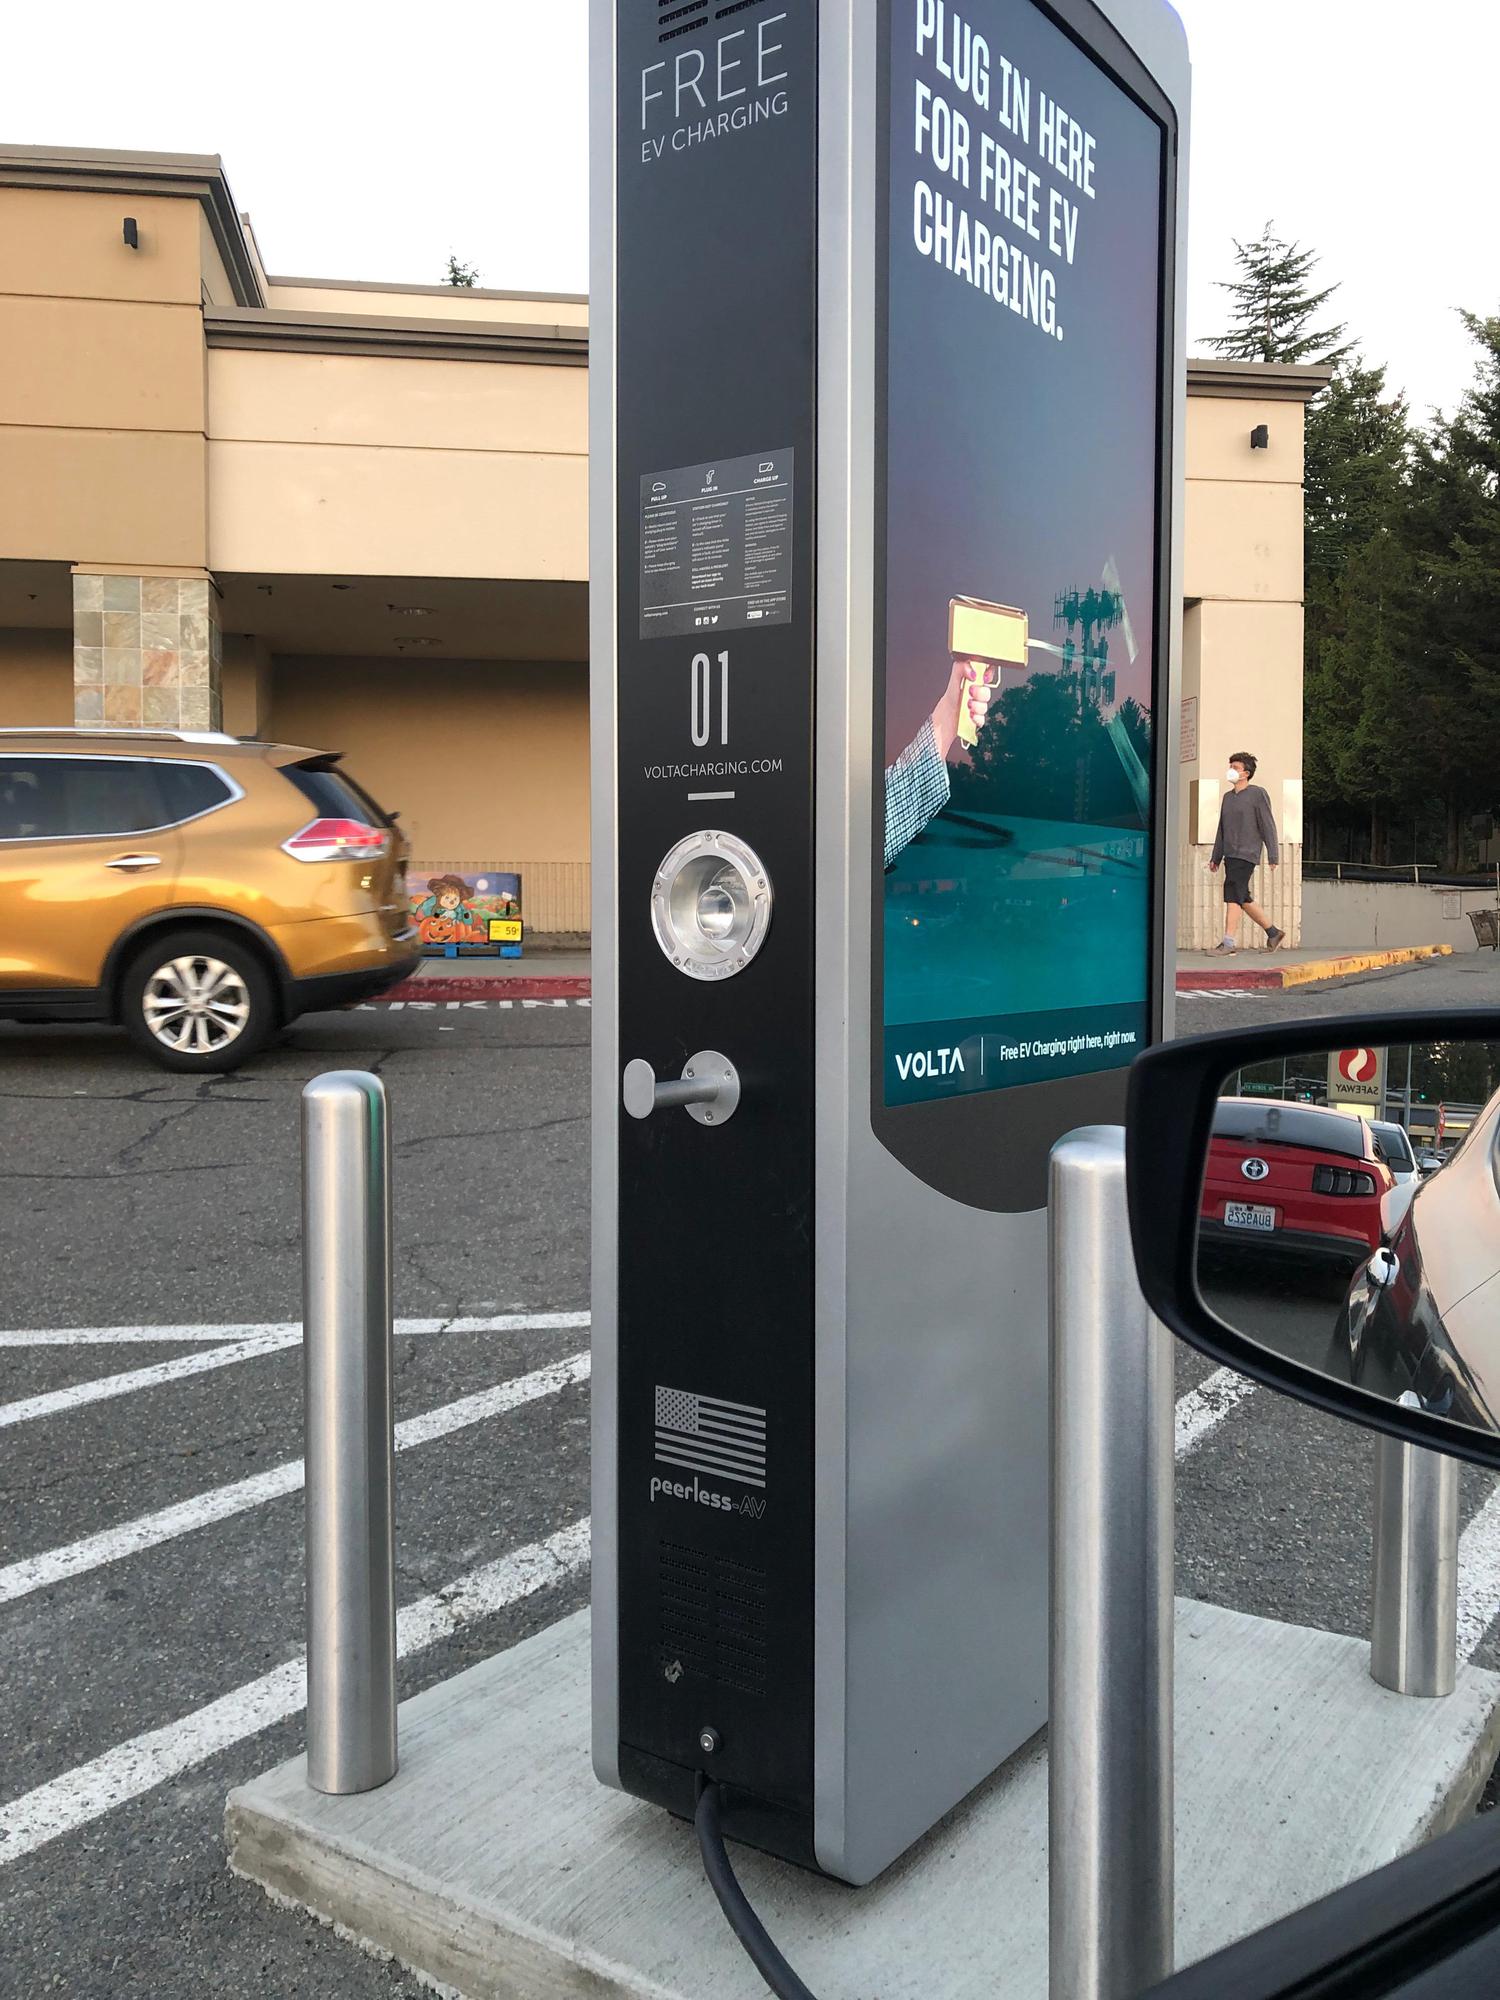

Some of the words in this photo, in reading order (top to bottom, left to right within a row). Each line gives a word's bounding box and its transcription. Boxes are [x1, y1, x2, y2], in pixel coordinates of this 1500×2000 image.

[641, 12, 788, 131] FREE
[916, 0, 990, 112] PLUG
[999, 55, 1030, 144] IN
[1039, 91, 1097, 200] HERE
[641, 135, 666, 163] EV
[671, 91, 789, 151] CHARGING
[914, 78, 971, 189] FOR
[980, 132, 1041, 240] FREE
[1048, 186, 1078, 265] EV
[912, 179, 1065, 342] CHARGING.
[691, 650, 729, 747] 01
[643, 758, 783, 779] VOLTACHARGING.COM
[895, 1046, 965, 1081] VOLTA
[1000, 1044, 1018, 1061] Free
[1019, 1042, 1032, 1058] EV
[1032, 1039, 1067, 1058] Charging
[1067, 1035, 1085, 1054] right
[1085, 1033, 1104, 1051] here,
[1103, 1030, 1121, 1048] right
[1120, 1031, 1137, 1045] now.
[650, 1476, 767, 1520] peerless-AV
